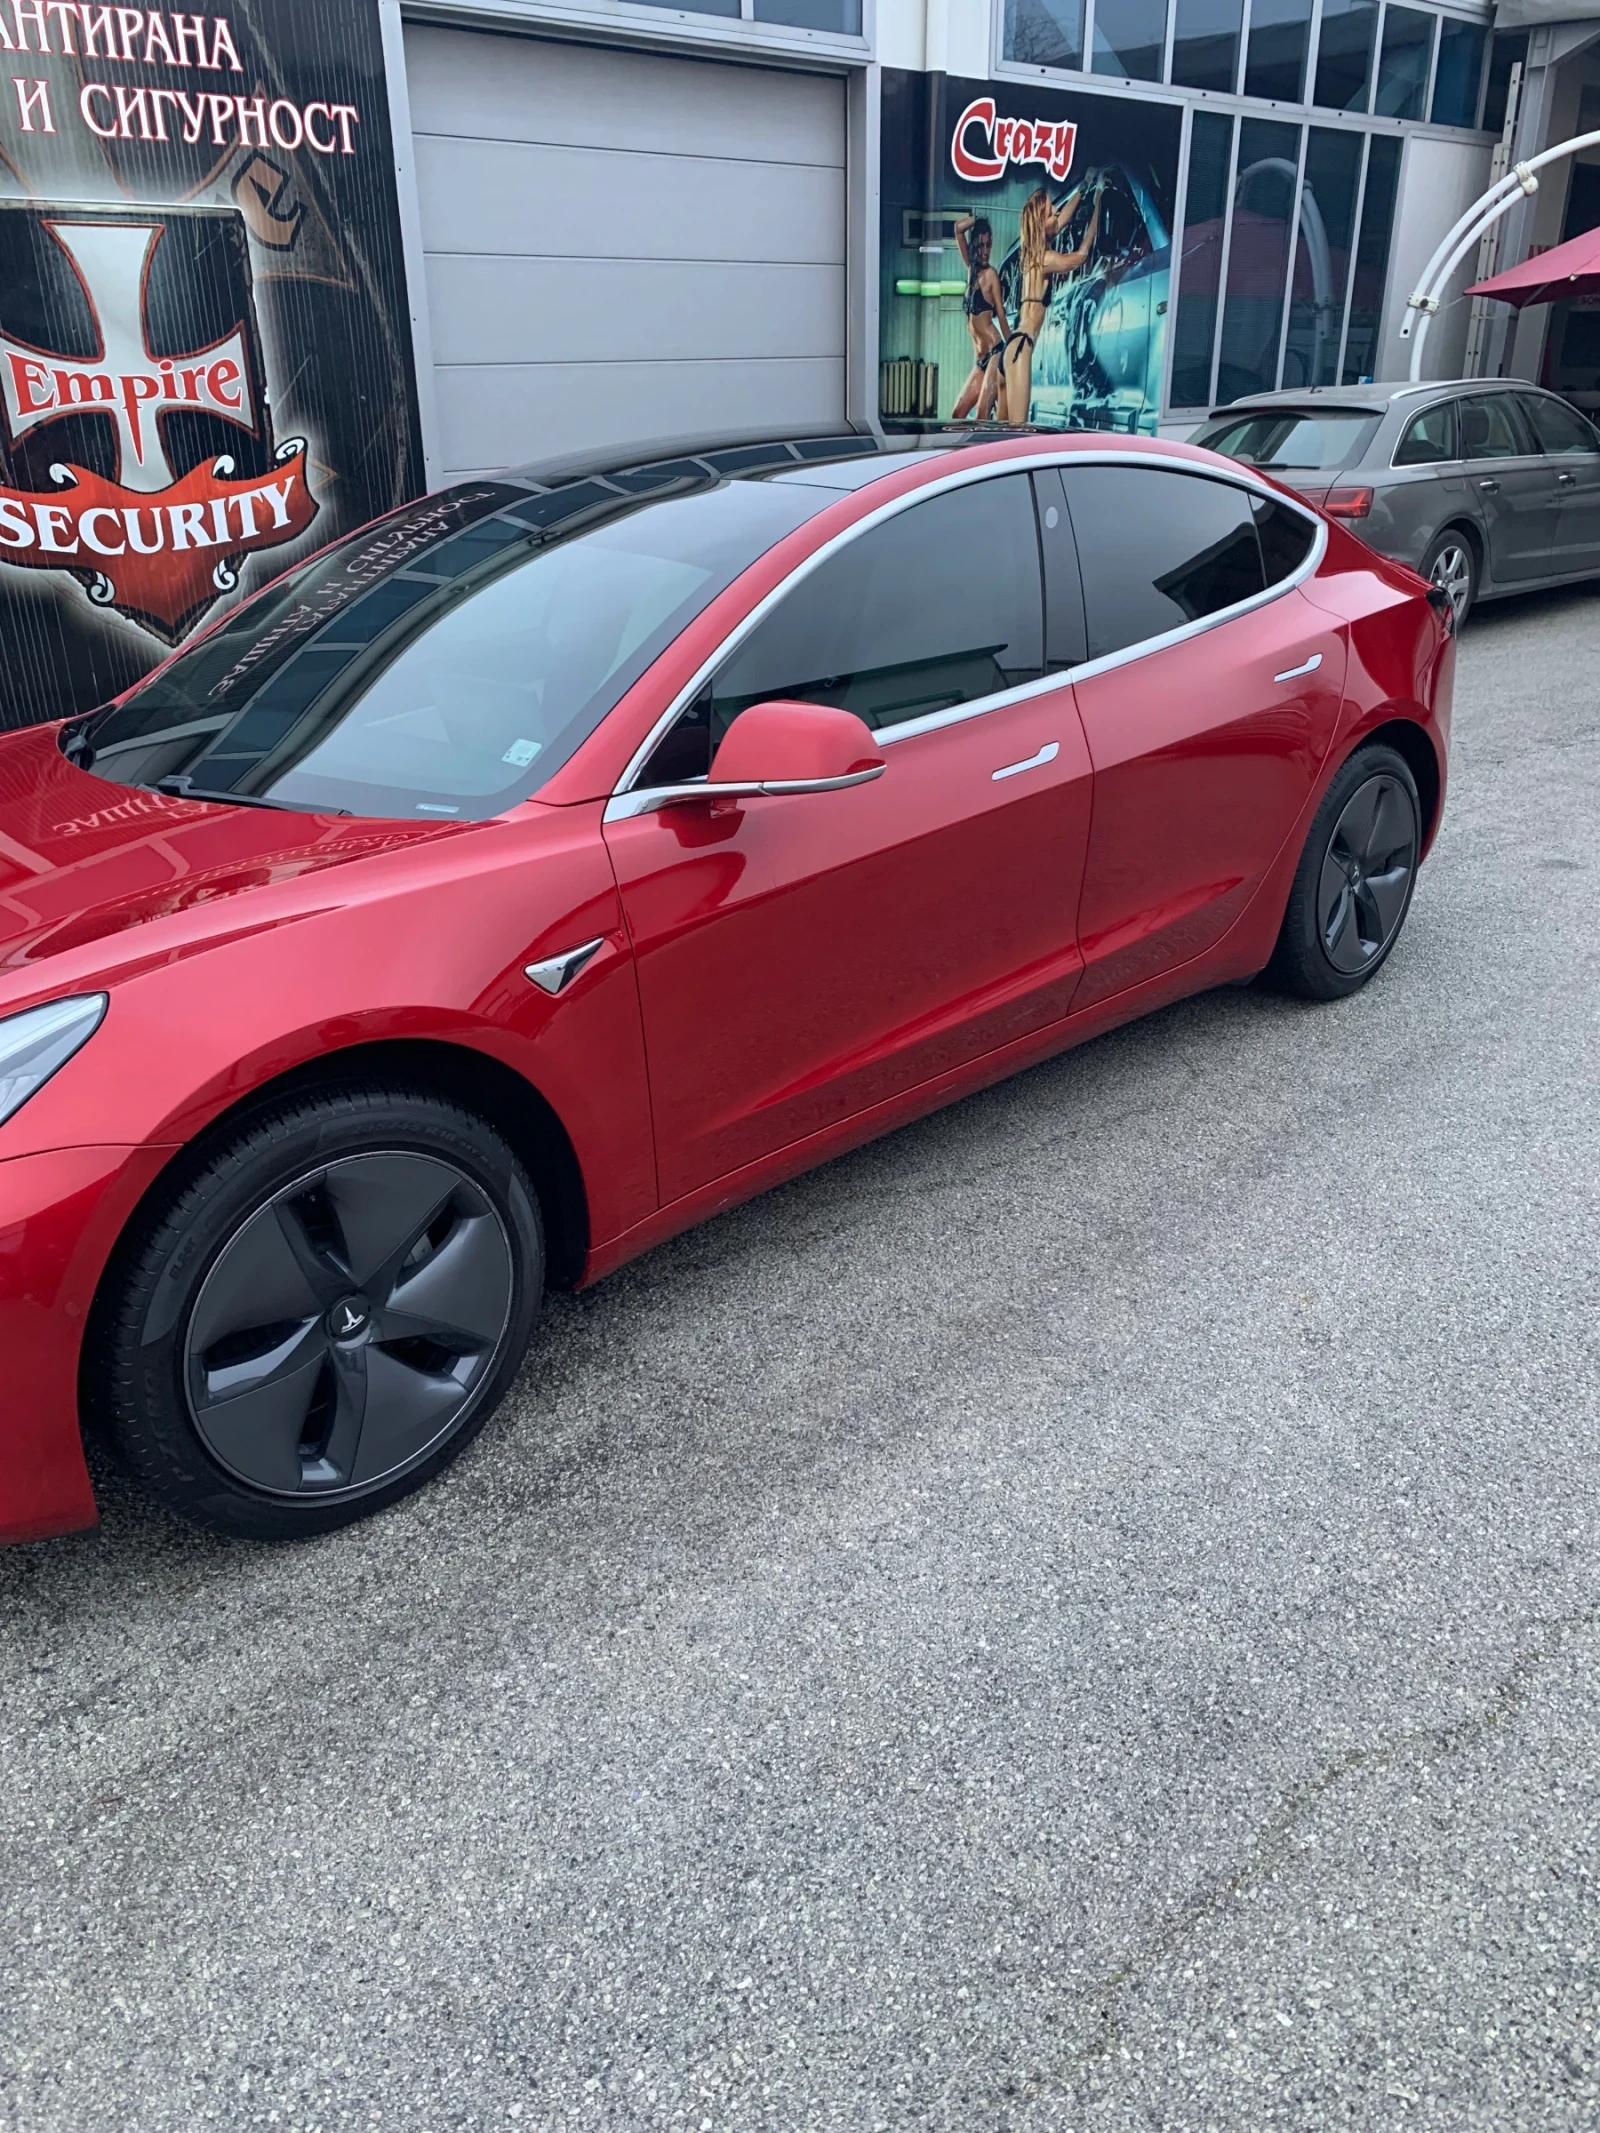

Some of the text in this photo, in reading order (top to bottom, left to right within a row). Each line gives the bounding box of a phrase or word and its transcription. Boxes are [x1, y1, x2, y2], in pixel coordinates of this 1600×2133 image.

[12, 78, 359, 154] И СИГУРНОСТ
[951, 97, 1078, 182] Crazy
[5, 350, 242, 466] Empire
[0, 476, 295, 556] SECURITY
